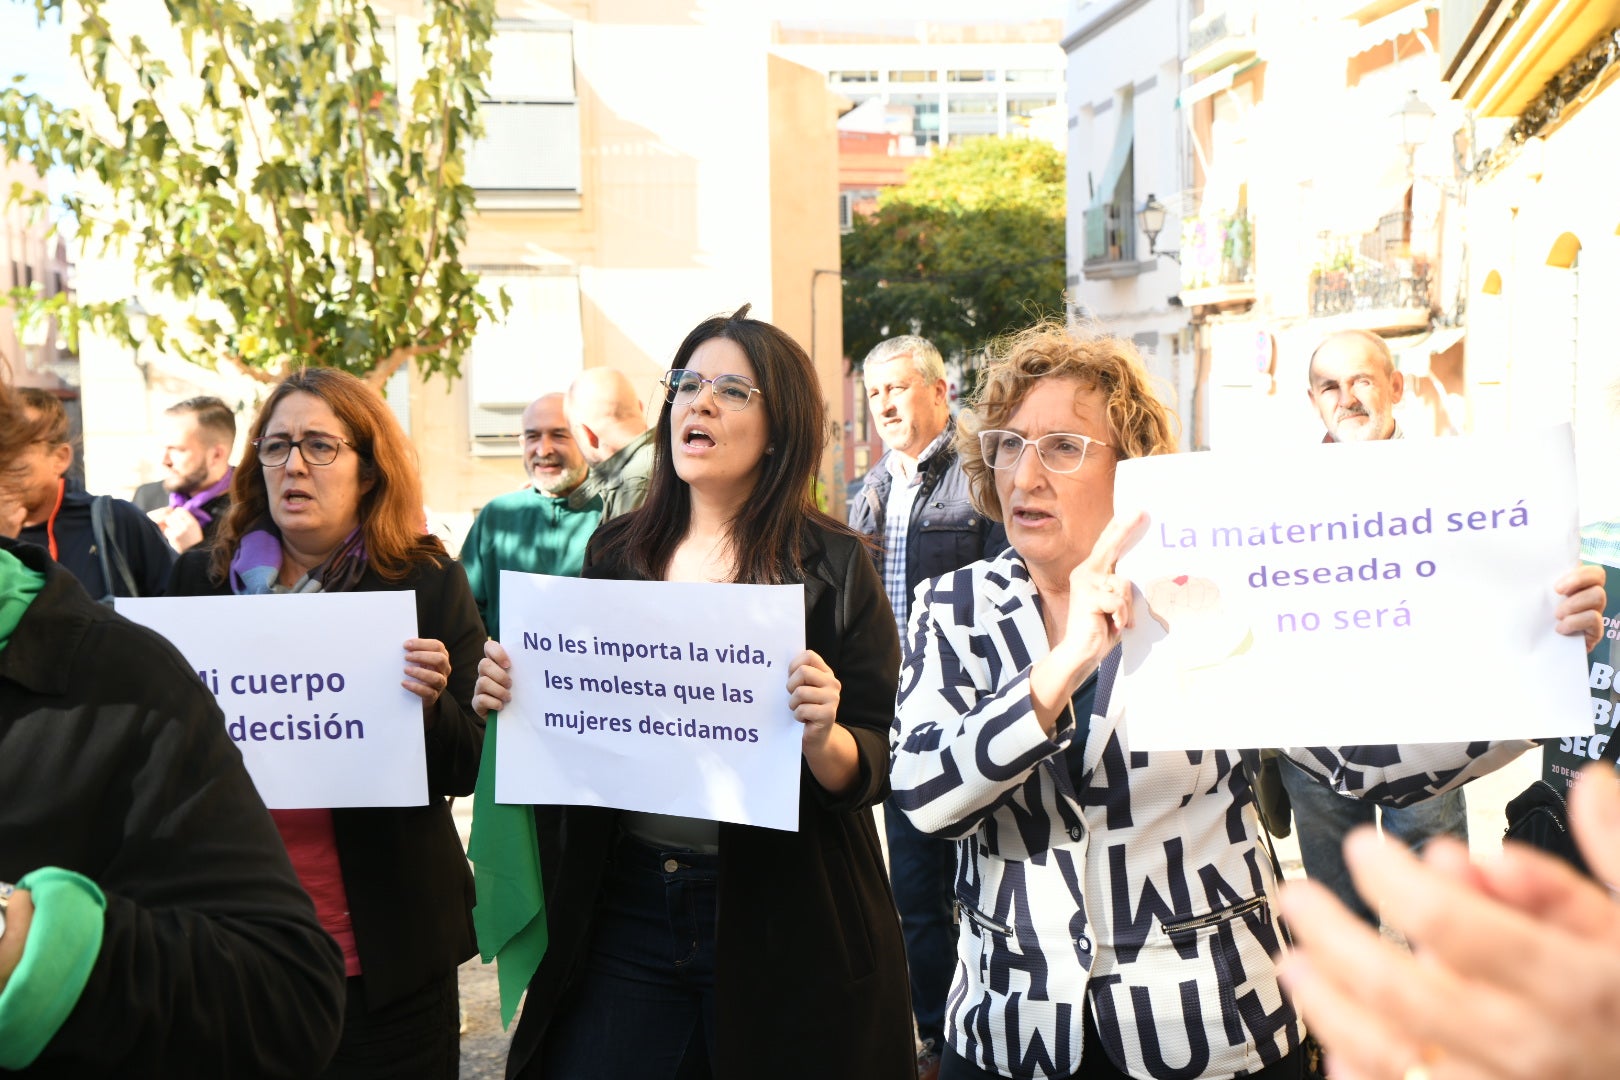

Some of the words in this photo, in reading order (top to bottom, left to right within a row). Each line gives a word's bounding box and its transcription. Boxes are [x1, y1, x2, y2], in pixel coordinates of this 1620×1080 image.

[1160, 522, 1197, 549] La
[1211, 508, 1433, 548] maternidad
[1446, 500, 1529, 532] será
[1247, 558, 1402, 589] deseada
[1415, 560, 1437, 578] o
[1276, 611, 1321, 633] no
[1333, 600, 1412, 631] será
[523, 631, 552, 651] No
[558, 633, 588, 654] les
[593, 636, 682, 663] importa
[689, 642, 709, 662] la
[715, 644, 772, 668] vida,
[230, 672, 345, 701] cuerpo
[544, 670, 574, 690] les
[579, 675, 667, 697] molesta
[673, 683, 715, 704] que
[722, 682, 754, 704] las
[228, 712, 365, 742] decisión
[544, 710, 632, 734] mujeres
[638, 716, 759, 743] decidamos
[1551, 764, 1560, 774] 20
